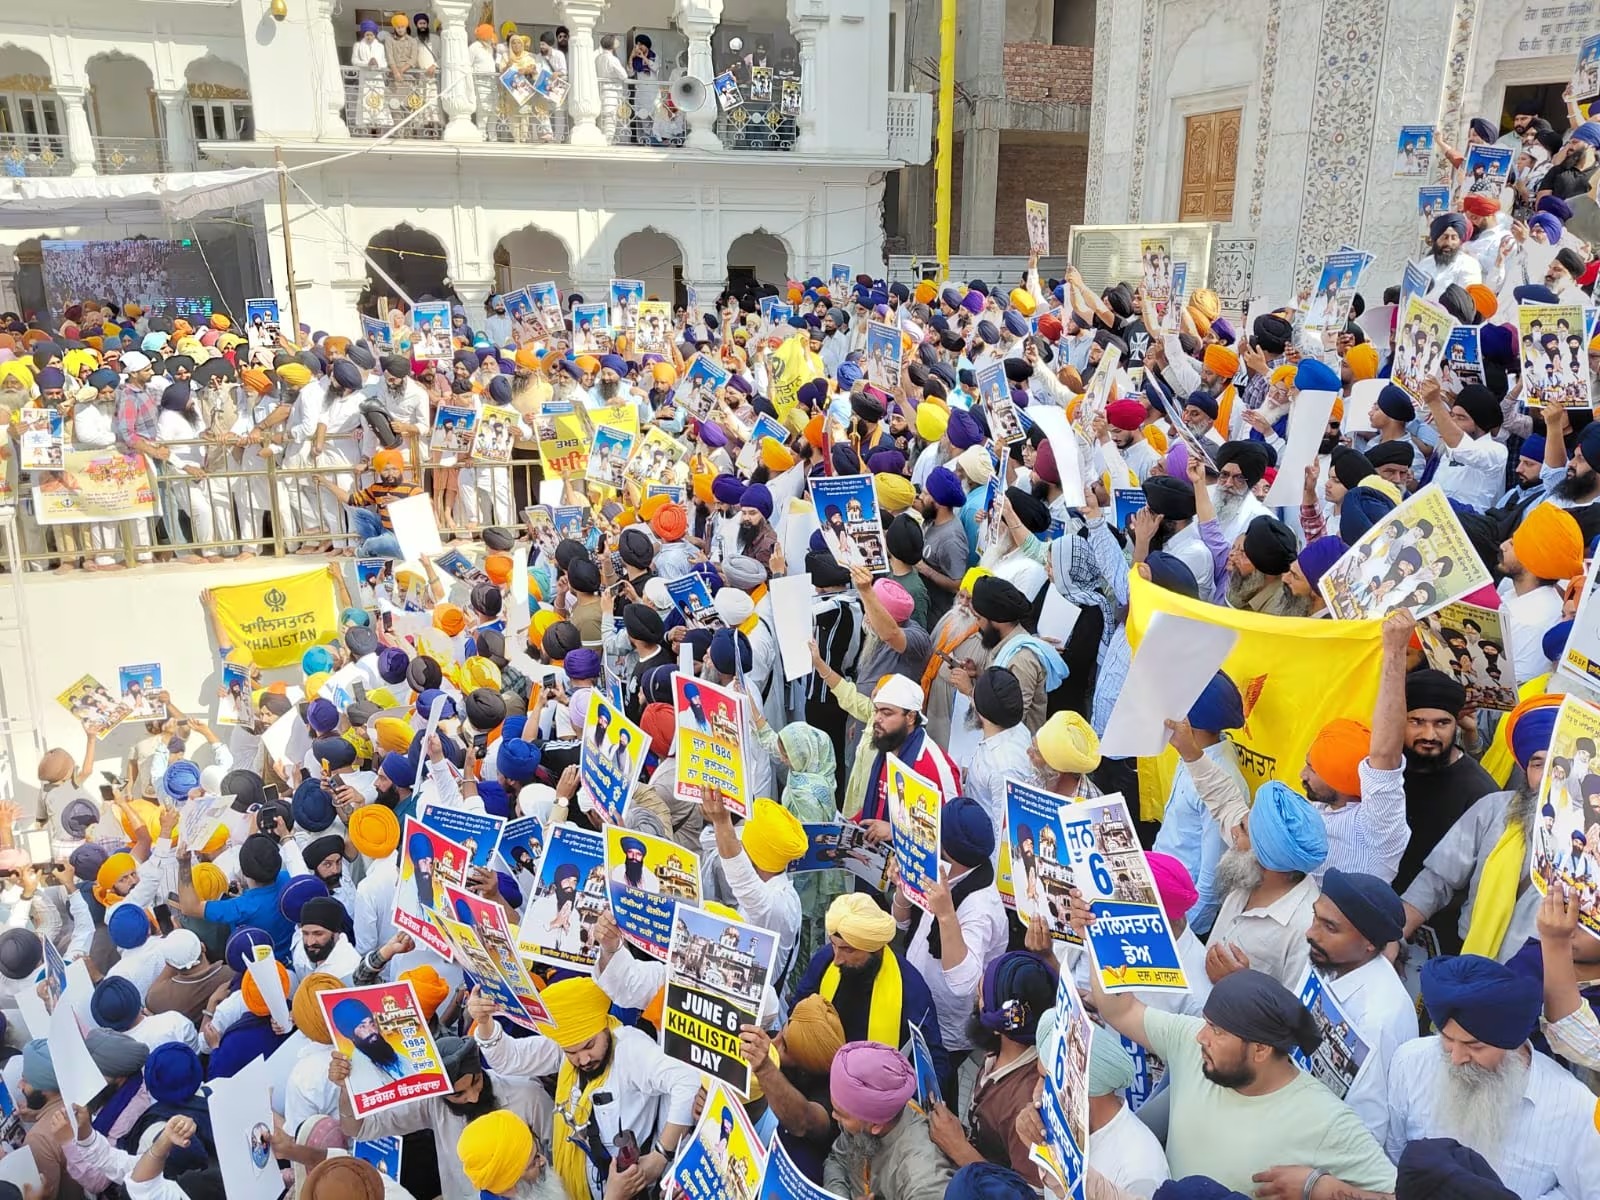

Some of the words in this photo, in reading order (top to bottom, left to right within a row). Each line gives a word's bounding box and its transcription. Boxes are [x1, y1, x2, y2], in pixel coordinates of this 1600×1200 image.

[243, 628, 317, 650] KHALISTAN
[710, 743, 731, 760] 1984
[1066, 820, 1094, 863] ਜੂਨ
[1088, 853, 1113, 896] 6
[681, 992, 722, 1025] JUNE
[727, 1011, 737, 1031] 6
[403, 1038, 425, 1048] 1984
[690, 1044, 722, 1073] DAY
[1056, 1035, 1066, 1092] 6
